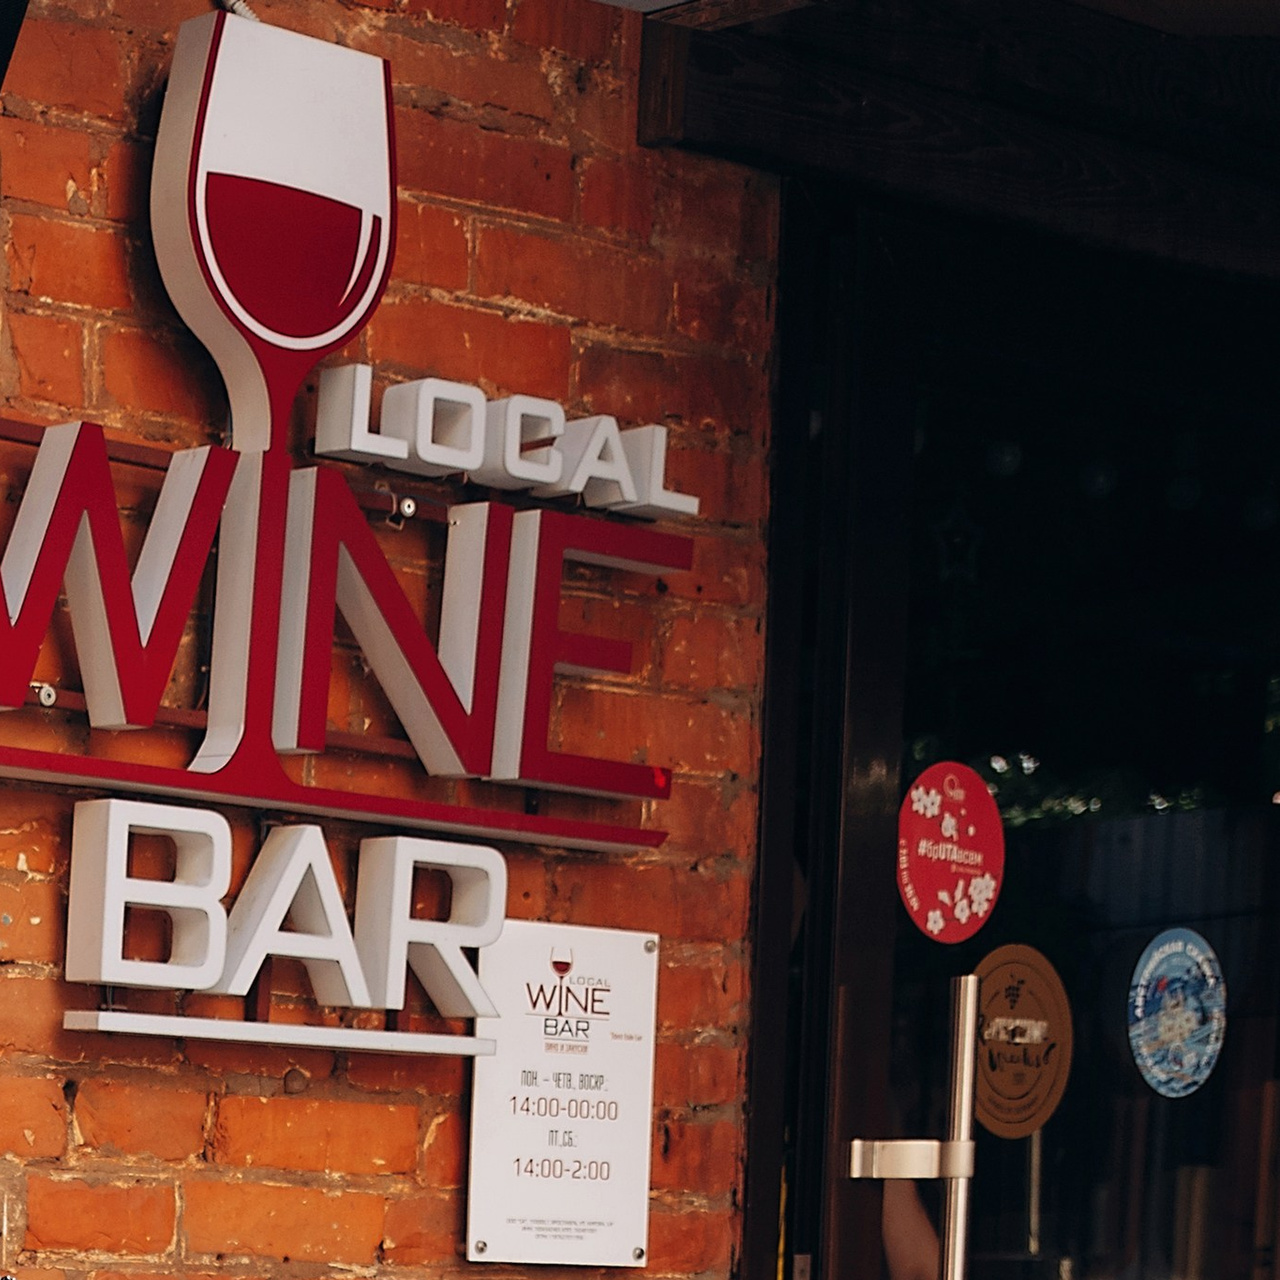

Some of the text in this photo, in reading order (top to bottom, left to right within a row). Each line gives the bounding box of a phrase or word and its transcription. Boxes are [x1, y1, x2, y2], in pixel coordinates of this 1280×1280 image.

[316, 364, 700, 516] LOCAL
[65, 799, 508, 1018] BAR
[569, 976, 611, 987] LOCAL
[525, 981, 611, 1016] WINE
[544, 1018, 590, 1039] BAR
[510, 1096, 618, 1121] 14:00-00:00
[513, 1158, 610, 1181] 14:00-2:00
